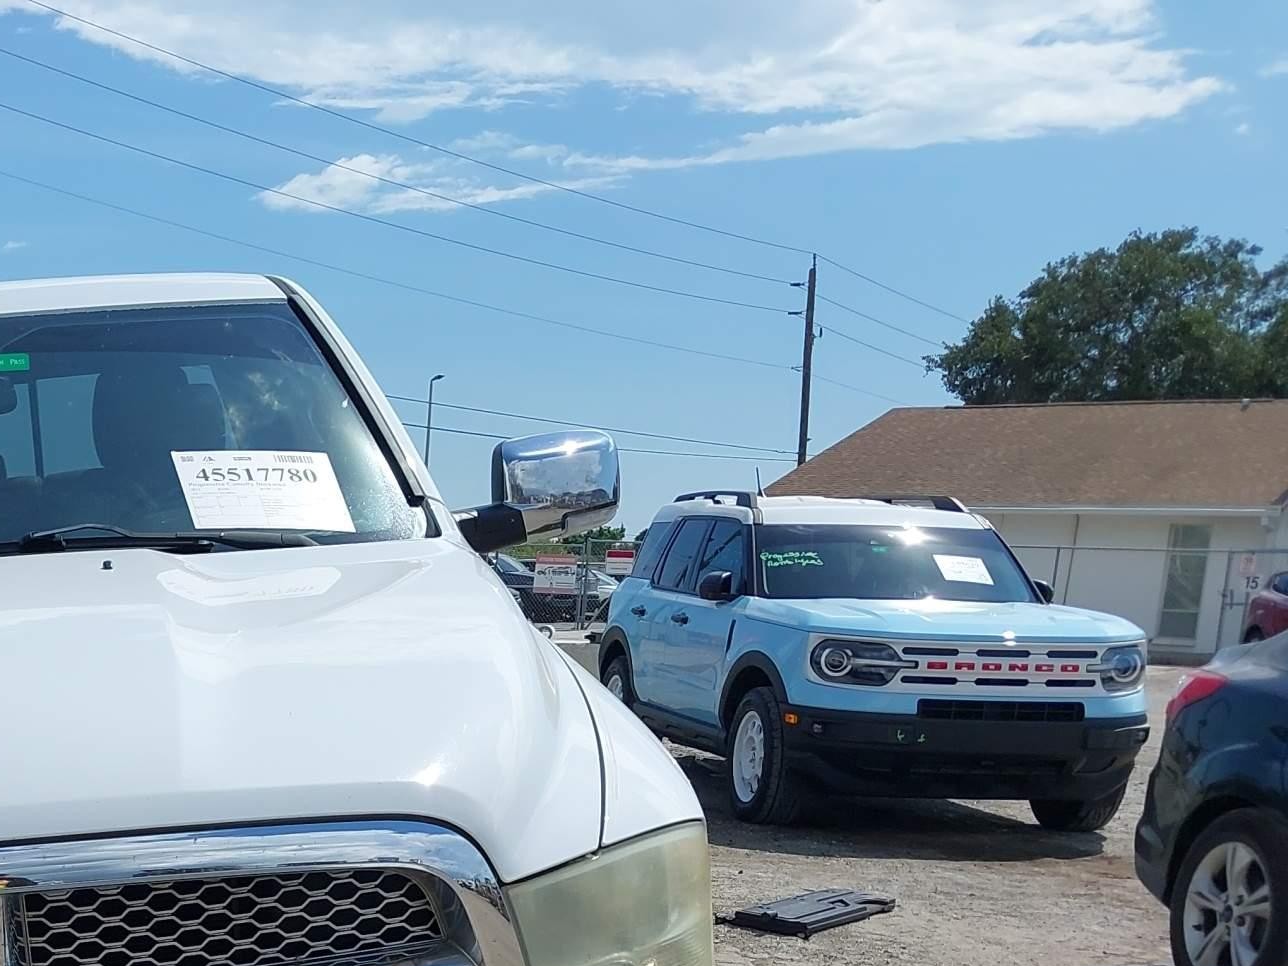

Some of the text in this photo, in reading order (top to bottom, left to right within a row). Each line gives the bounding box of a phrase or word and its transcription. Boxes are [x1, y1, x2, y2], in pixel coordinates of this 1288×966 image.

[196, 468, 317, 483] 45517780
[1245, 575, 1260, 590] 15
[926, 661, 1080, 673] BRONCO
